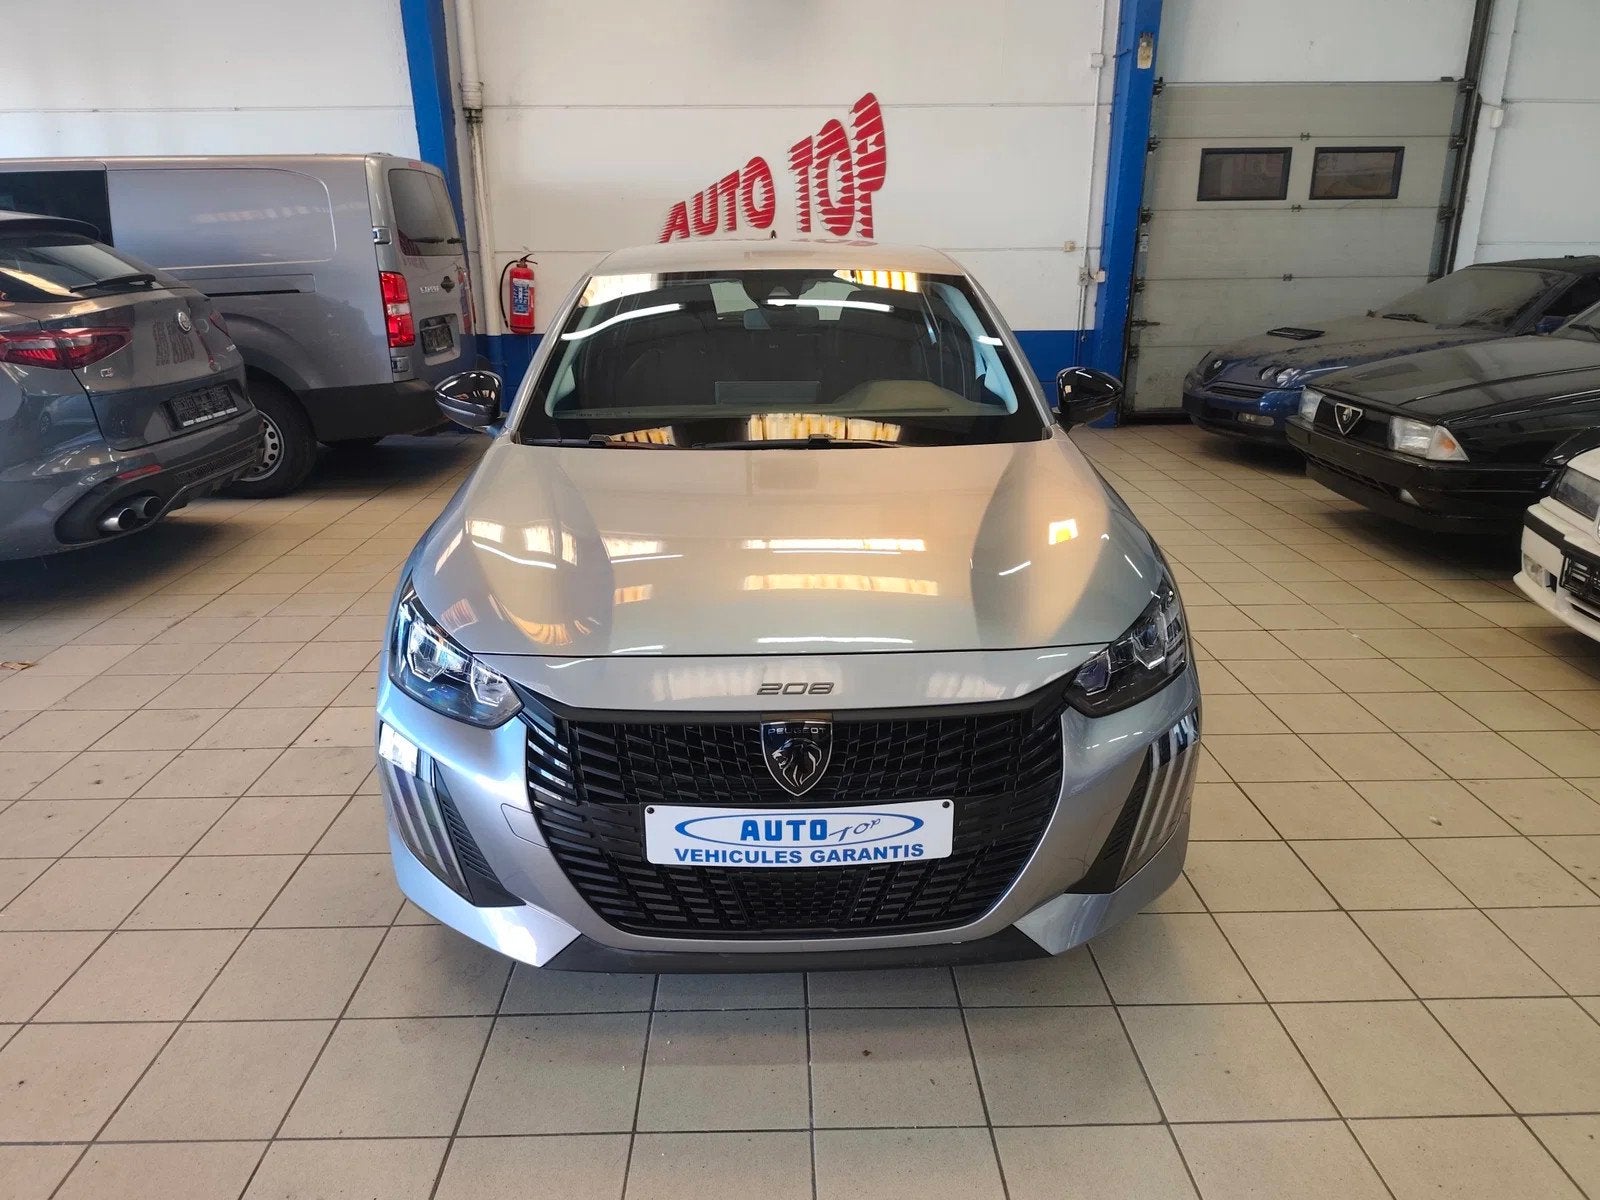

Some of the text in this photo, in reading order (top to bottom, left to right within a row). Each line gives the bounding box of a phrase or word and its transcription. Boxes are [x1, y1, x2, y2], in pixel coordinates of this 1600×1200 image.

[657, 92, 886, 243] AUTO TOP
[757, 682, 834, 696] 208
[767, 727, 826, 735] PEUGEOT
[740, 819, 827, 841] AUTO
[674, 843, 924, 864] VEHICULES GARANTIS
